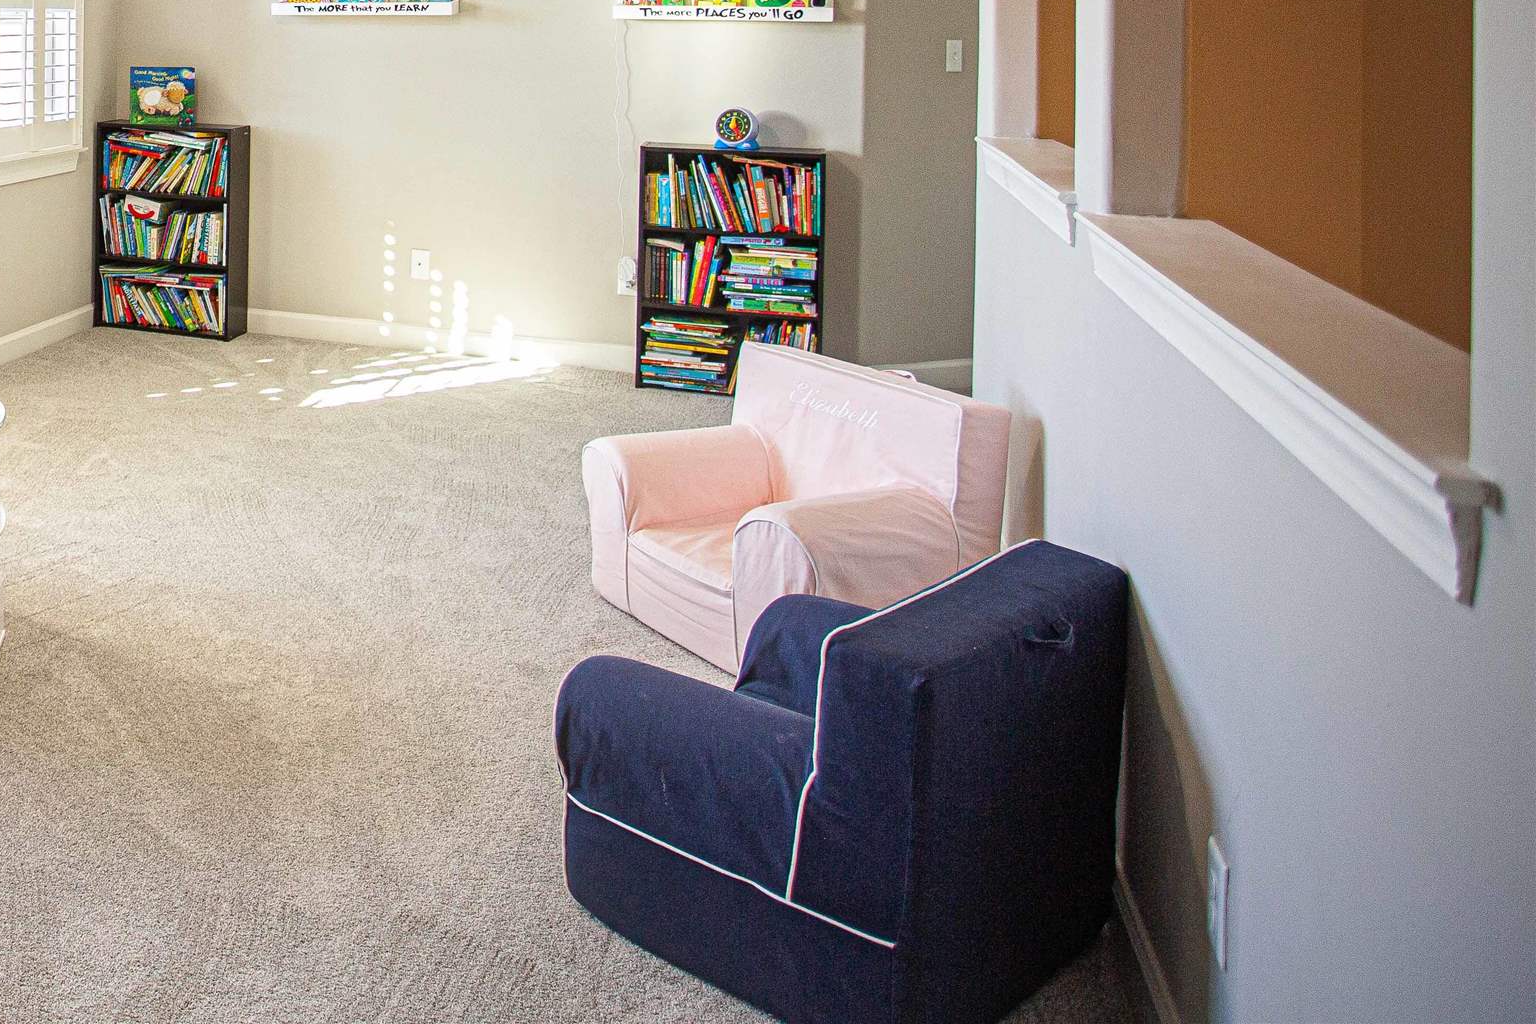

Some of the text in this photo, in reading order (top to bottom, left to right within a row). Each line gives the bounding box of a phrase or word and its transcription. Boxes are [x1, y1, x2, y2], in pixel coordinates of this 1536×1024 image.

[294, 3, 430, 14] The MORE that you LEARN
[639, 7, 663, 17] The
[695, 8, 746, 18] PLACES
[748, 8, 780, 20] you'll
[783, 9, 804, 20] GO
[789, 381, 880, 430] Elizabeth
